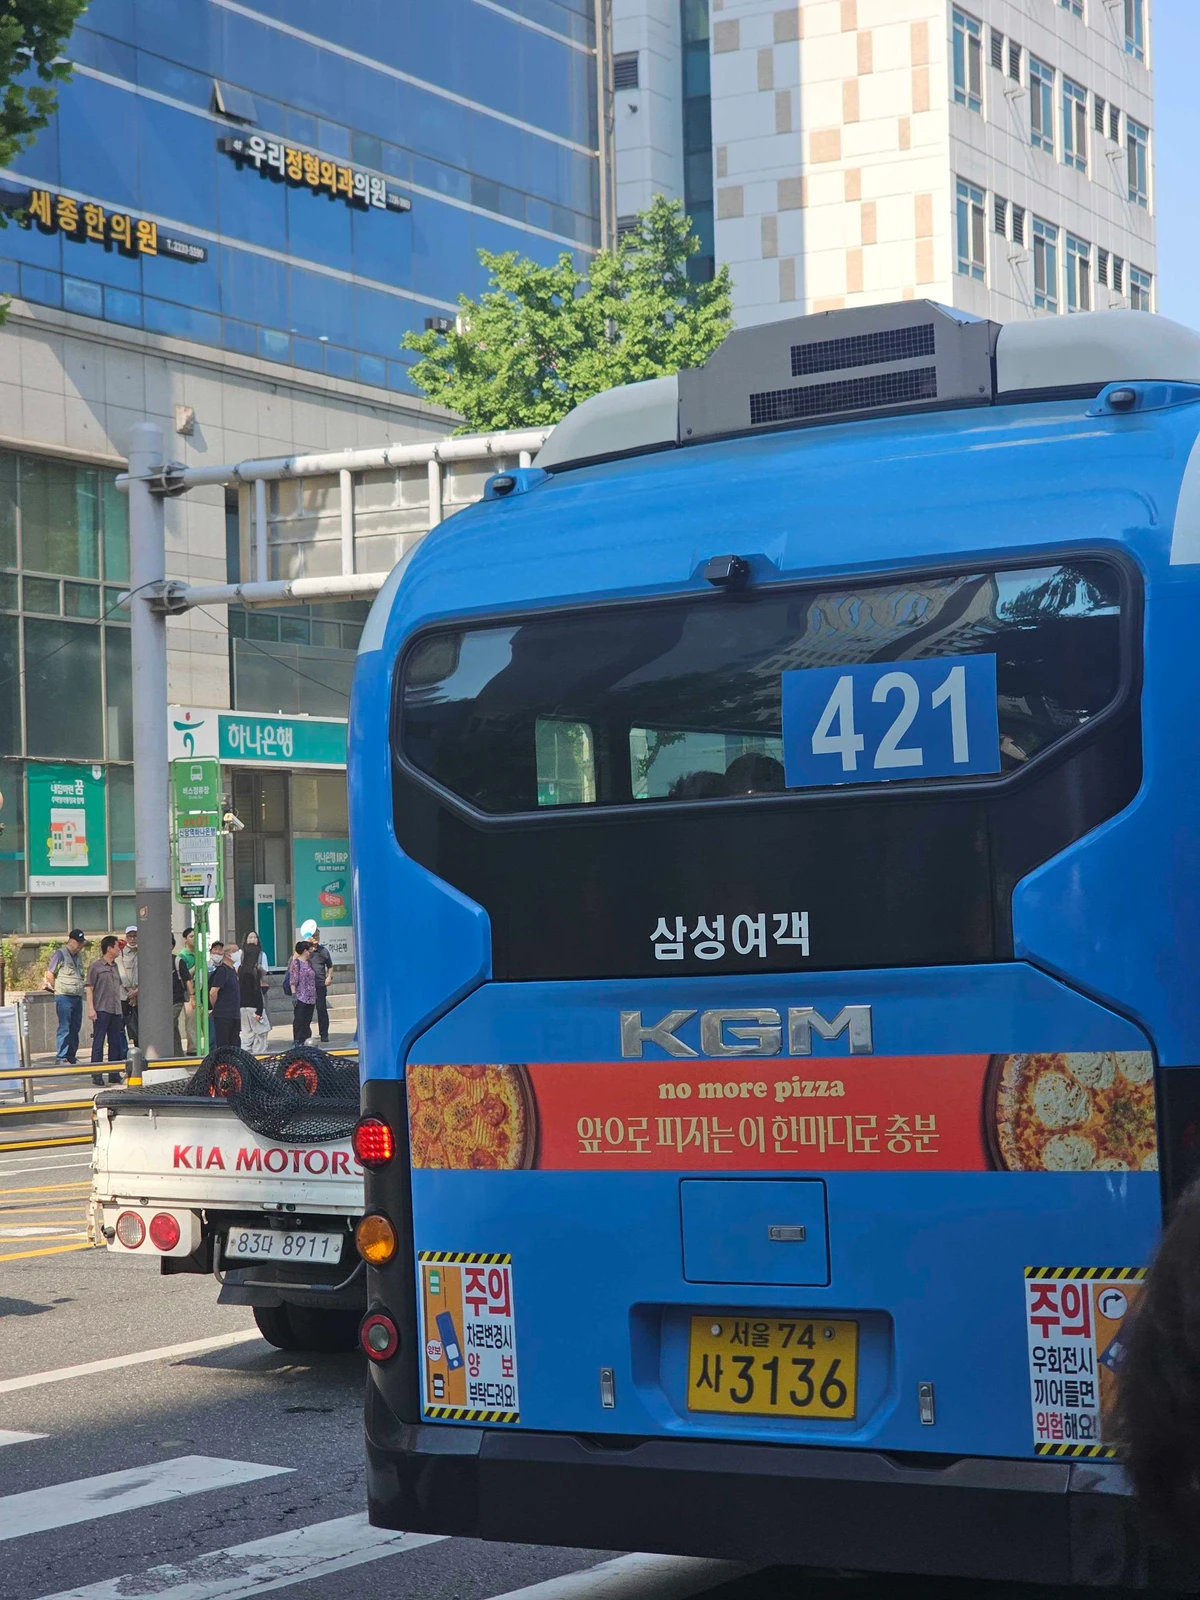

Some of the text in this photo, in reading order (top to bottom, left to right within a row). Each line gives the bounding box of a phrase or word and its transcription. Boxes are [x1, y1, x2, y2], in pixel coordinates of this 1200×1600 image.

[249, 136, 387, 209] 우리정형외과의원
[29, 190, 158, 255] 세종한의원
[812, 666, 969, 771] 421
[228, 723, 294, 757] 하나은행
[649, 911, 810, 960] 삼성여객
[620, 1005, 873, 1057] KGM
[658, 1076, 846, 1103] no more pizza
[577, 1114, 940, 1154] 앞으로 피자는 이 한마디로 충분
[173, 1144, 226, 1171] KIA
[282, 1235, 330, 1258] 8911
[465, 1267, 511, 1317] 주의
[1030, 1283, 1092, 1338] 주의
[466, 1323, 513, 1350] 차로변경시
[730, 1321, 816, 1350] 서울 74
[467, 1352, 515, 1378] 양 보
[1032, 1346, 1093, 1375] 우회전시
[469, 1382, 516, 1408] 부탁드려요!
[1034, 1379, 1095, 1409] 끼어들면
